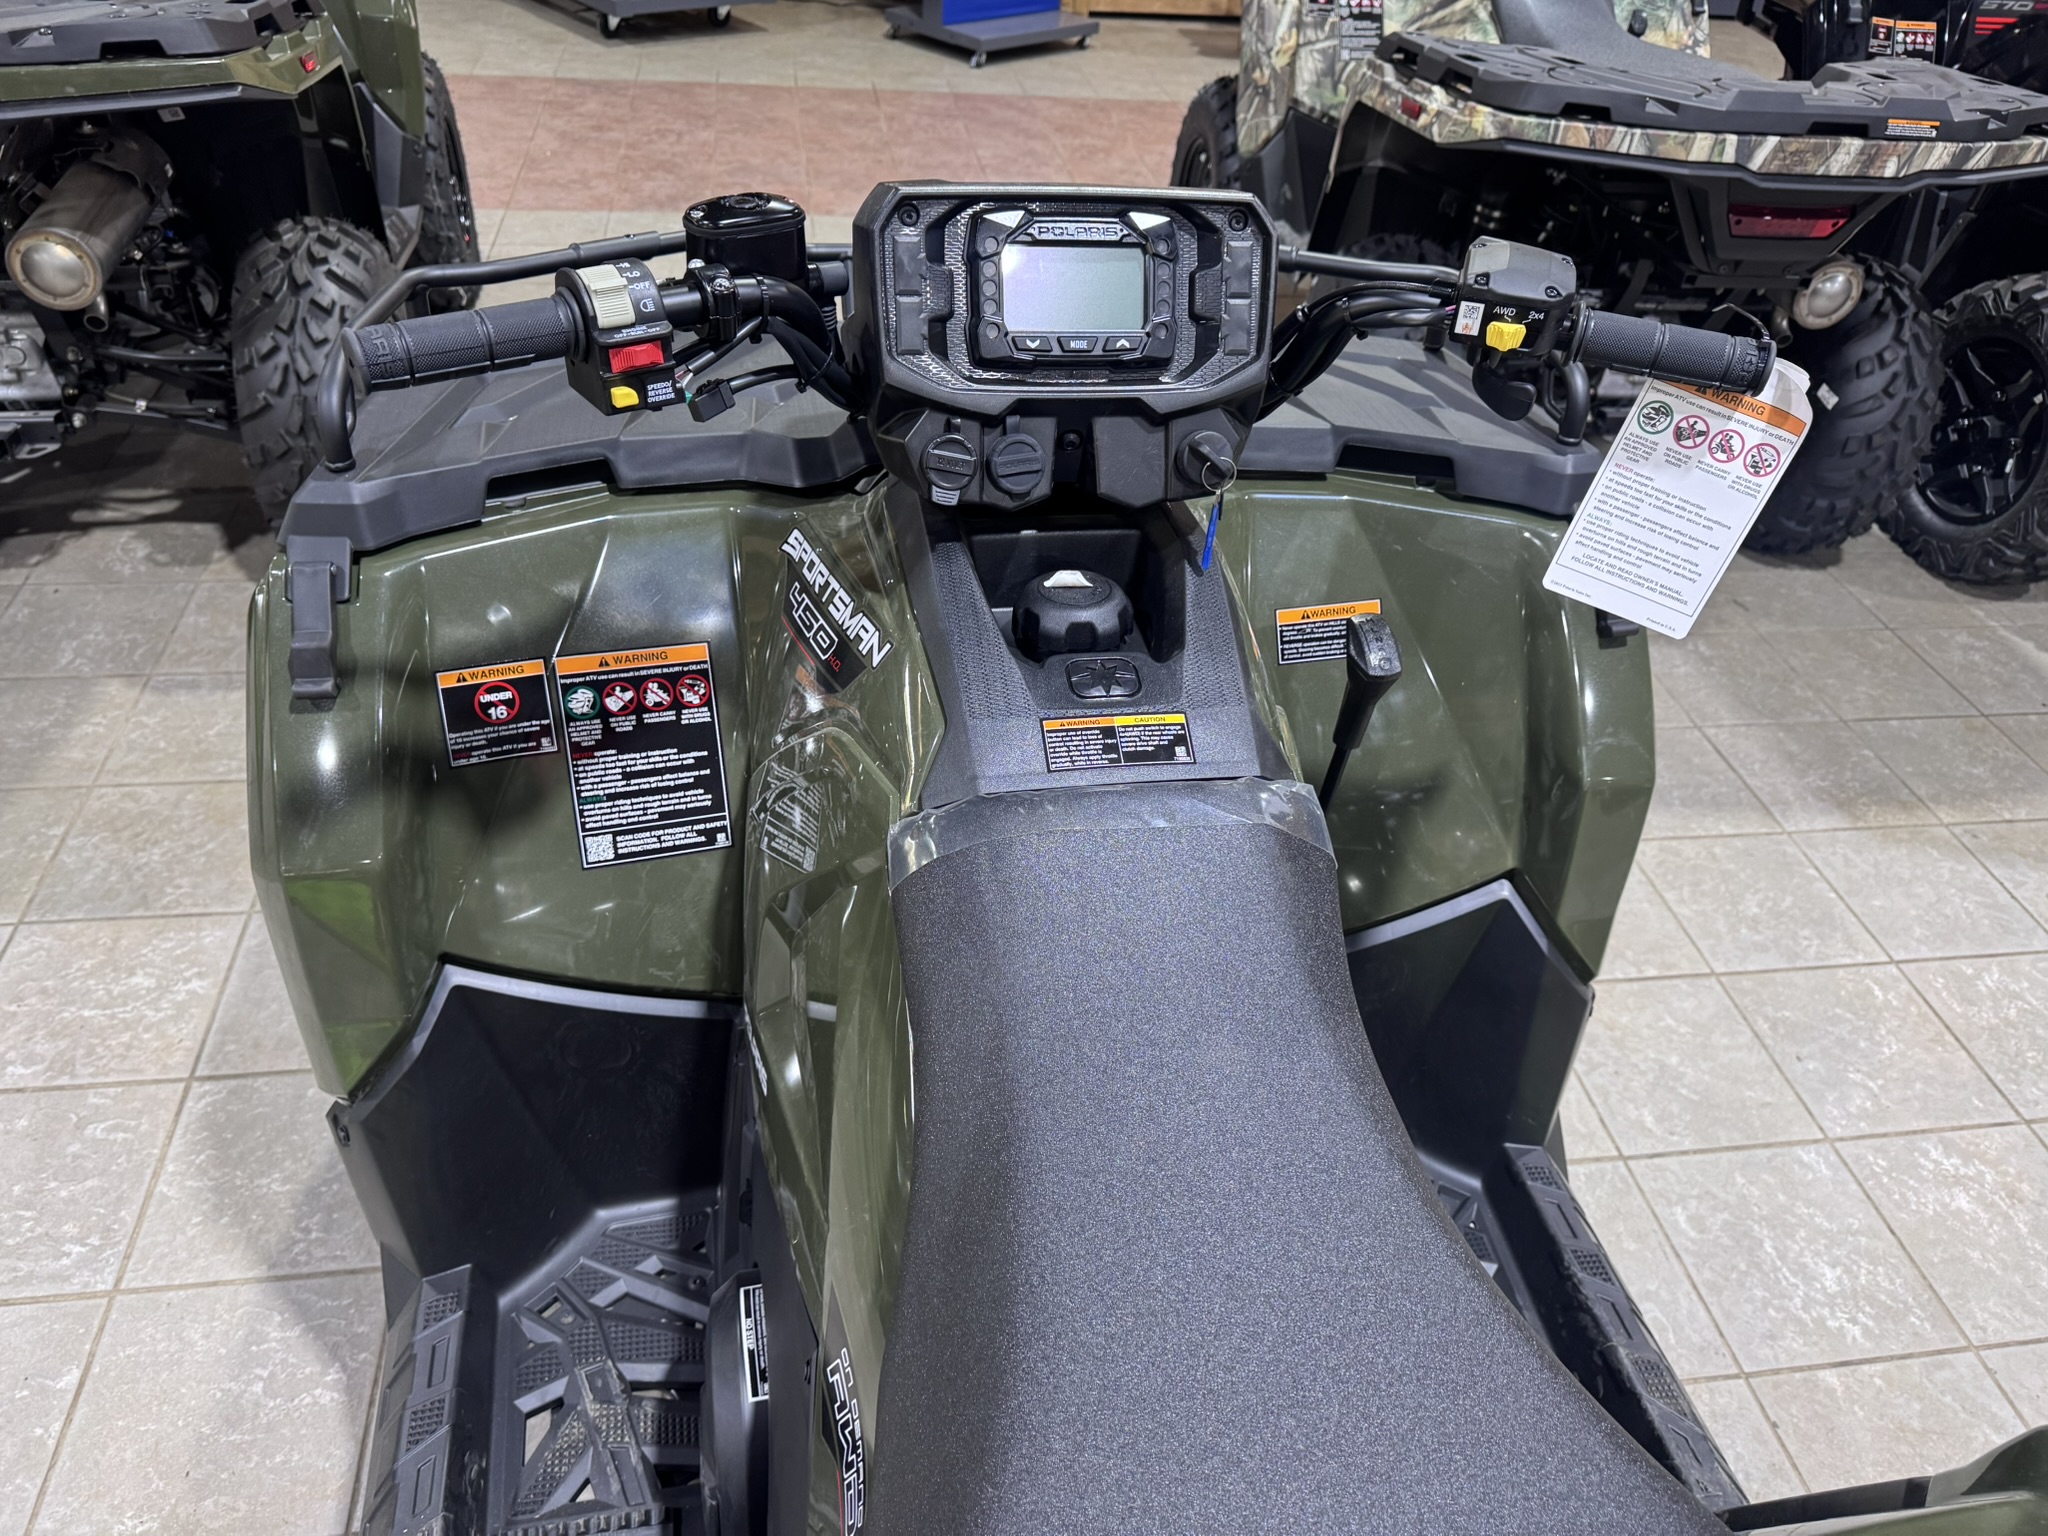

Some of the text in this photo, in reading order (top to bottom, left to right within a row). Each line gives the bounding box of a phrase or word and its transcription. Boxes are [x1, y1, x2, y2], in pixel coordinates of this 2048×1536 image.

[1038, 226, 1118, 238] POLARIS
[627, 270, 640, 278] LO
[634, 281, 650, 290] OFF
[1493, 306, 1516, 316] AWD
[1528, 311, 1545, 320] 2x4
[1070, 340, 1088, 349] MODE
[647, 380, 672, 390] SPEEDO/
[648, 388, 673, 396] REVERSE
[648, 393, 675, 403] OVERRIDE
[1710, 389, 1765, 416] WARNING
[1650, 384, 1675, 398] Improper
[1673, 394, 1686, 403] ATV
[1684, 398, 1696, 407] use
[1695, 402, 1707, 411] can
[1704, 406, 1722, 417] result
[1725, 414, 1749, 428] SEVERE
[1747, 423, 1769, 435] INJURY
[1773, 433, 1794, 445] DEATH
[781, 528, 892, 668] SPORTSMAN
[1310, 606, 1355, 617] WARNING
[789, 582, 839, 660] 450
[612, 651, 668, 664] WARNING
[468, 665, 524, 680] WARNING
[479, 691, 512, 702] UNDER
[487, 705, 508, 720] 16
[746, 1318, 754, 1350] NO STEP
